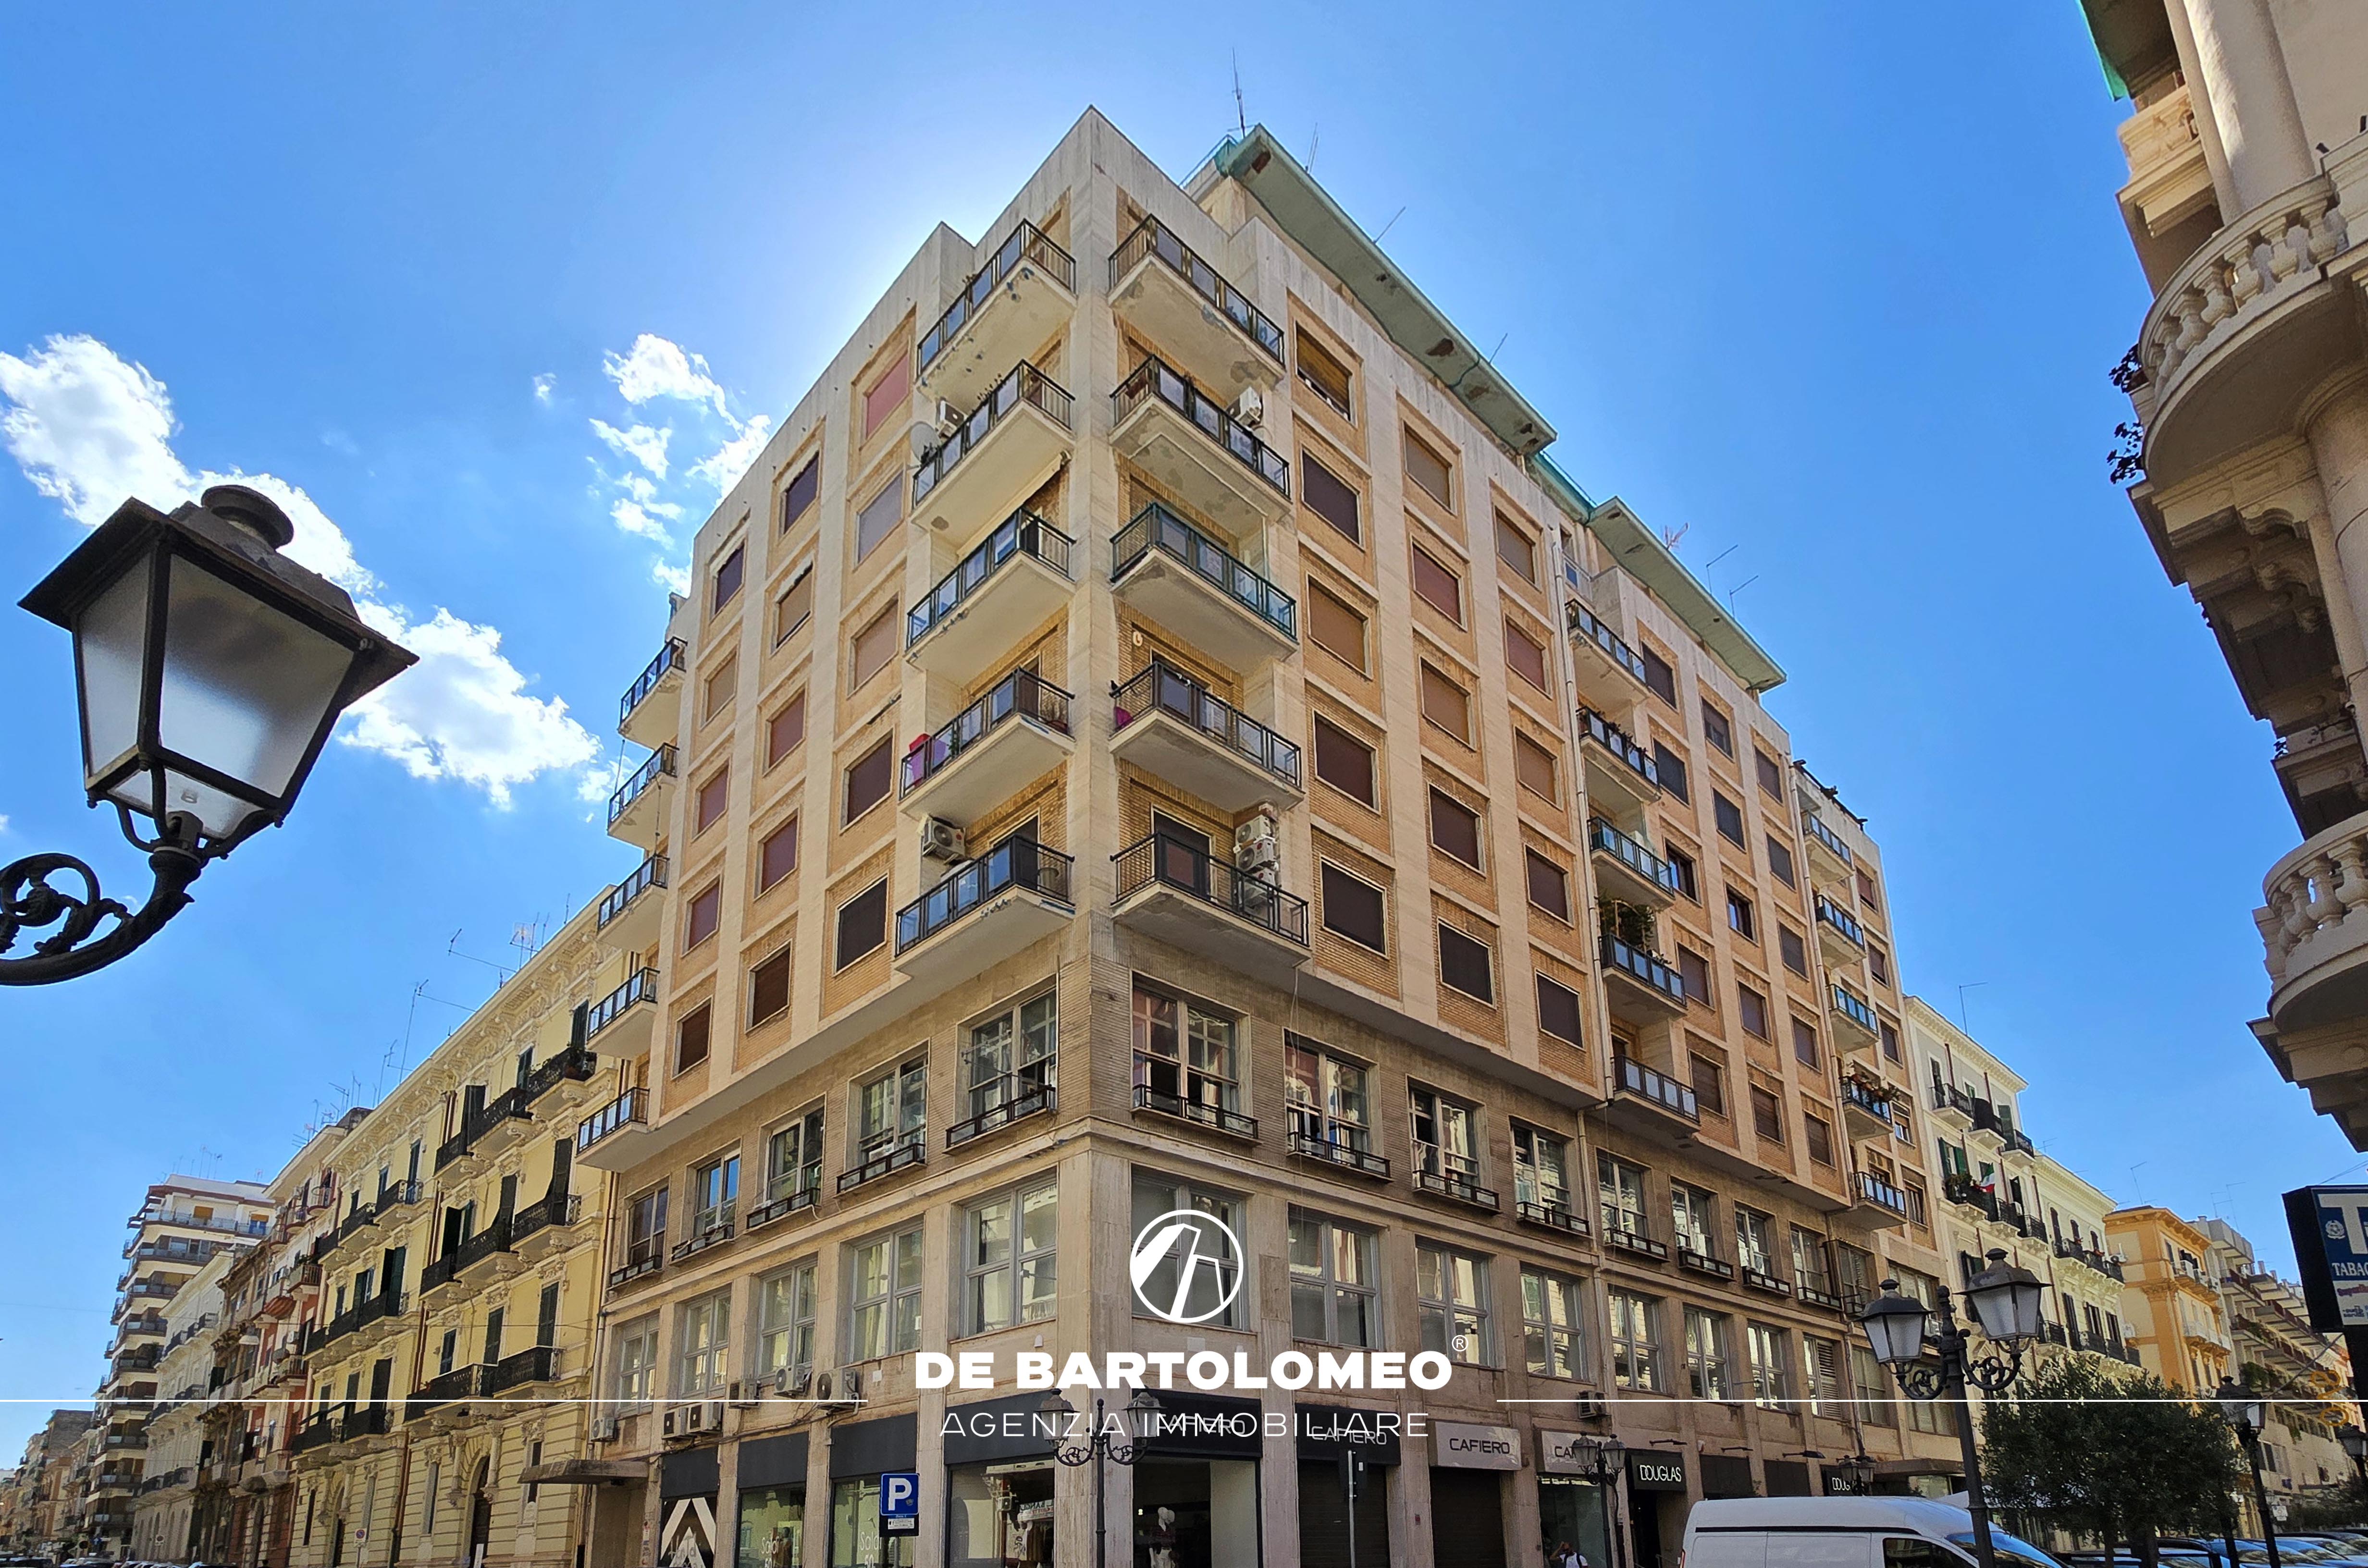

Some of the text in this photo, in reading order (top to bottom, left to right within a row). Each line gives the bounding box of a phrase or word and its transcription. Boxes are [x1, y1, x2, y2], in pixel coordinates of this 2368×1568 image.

[1311, 1426, 1387, 1445] CAFIERO
[1449, 1438, 1510, 1454] CAFIERO
[1640, 1464, 1682, 1482] DOUGLAS
[1832, 1477, 1851, 1491] DOUG
[888, 1478, 912, 1511] P
